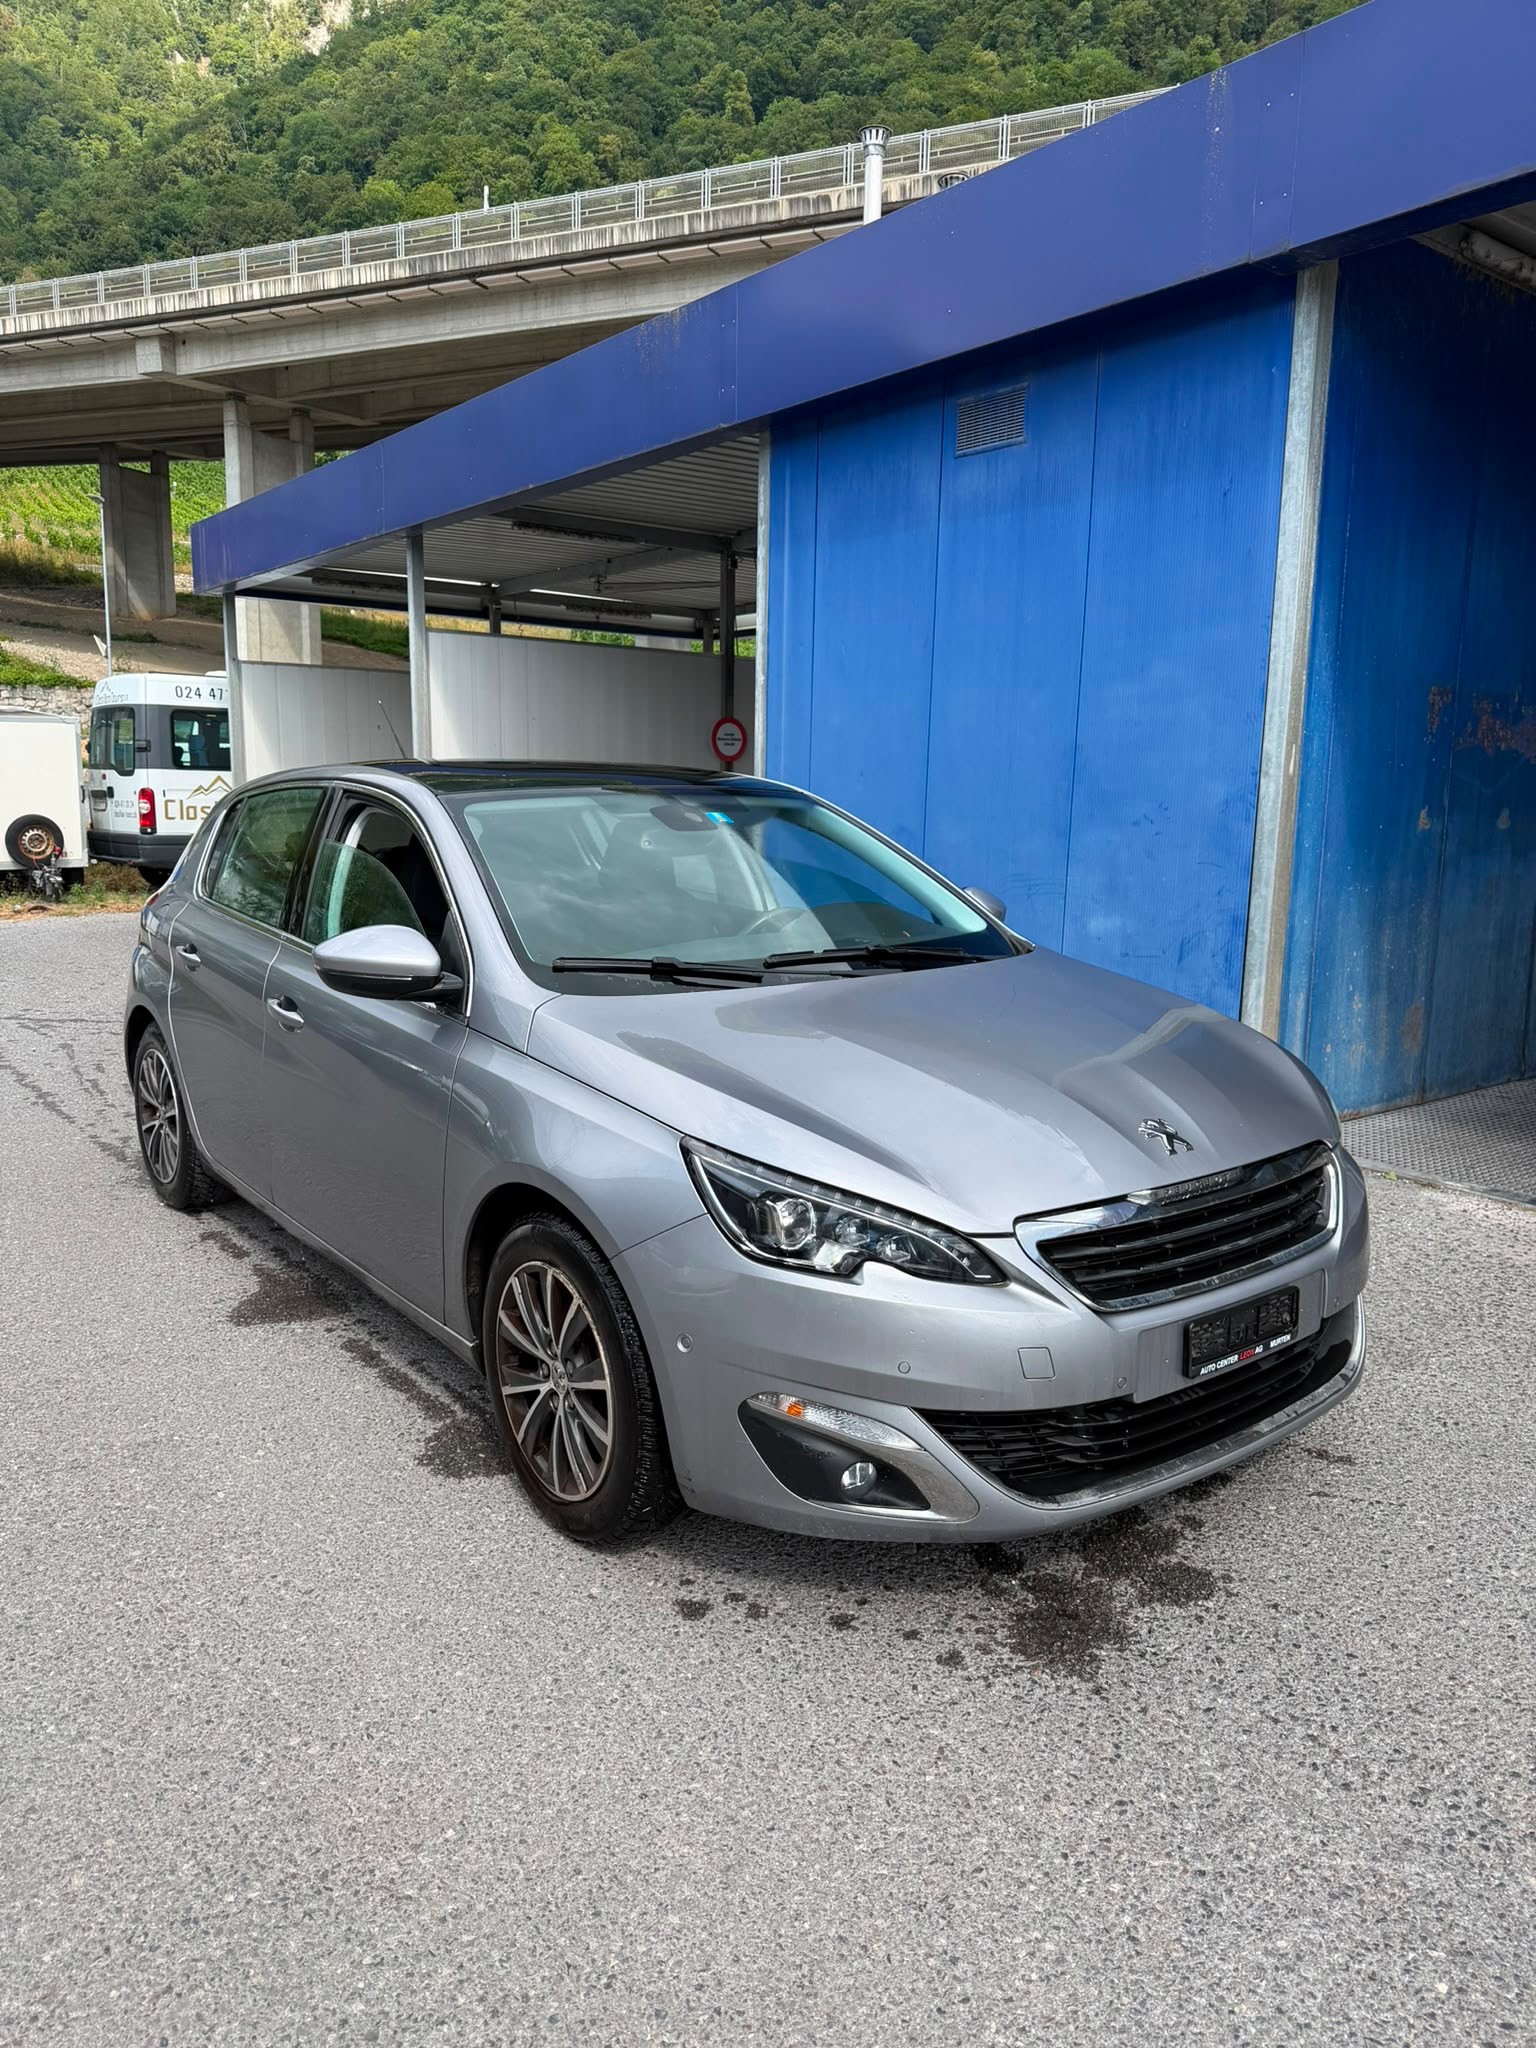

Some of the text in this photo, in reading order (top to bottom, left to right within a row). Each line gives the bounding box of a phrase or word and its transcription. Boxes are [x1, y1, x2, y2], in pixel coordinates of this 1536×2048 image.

[175, 685, 228, 701] 024 47
[164, 799, 217, 820] Clos
[1200, 1363, 1216, 1375] AUTO
[1216, 1354, 1239, 1369] CENTER
